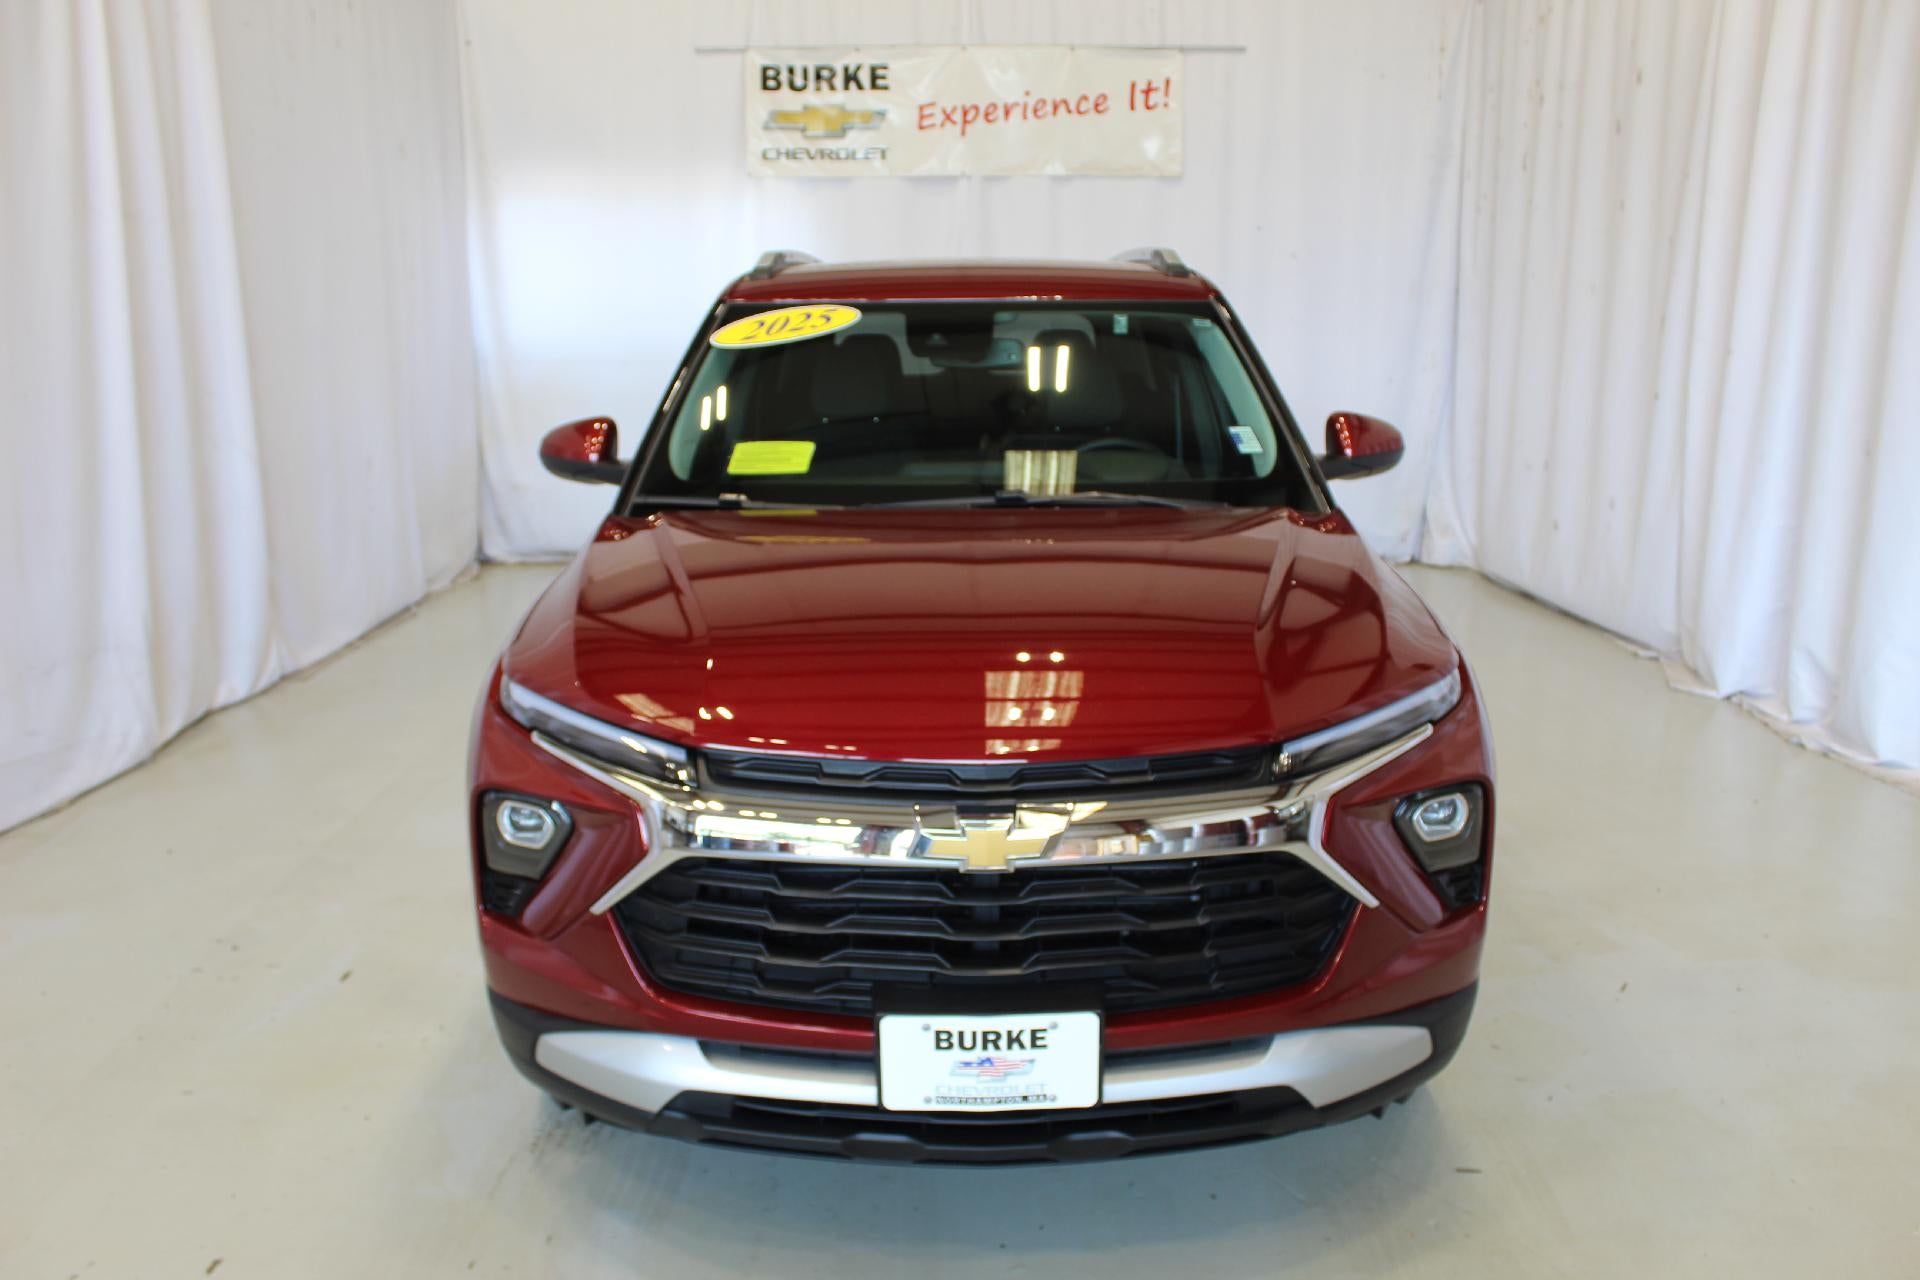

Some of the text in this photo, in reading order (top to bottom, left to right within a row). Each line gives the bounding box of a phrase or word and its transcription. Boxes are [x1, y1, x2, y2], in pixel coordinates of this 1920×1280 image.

[761, 64, 889, 91] BURKE
[917, 78, 1172, 136] Experience It!
[761, 147, 889, 160] CHEVROLET
[740, 307, 838, 341] 2025
[934, 1028, 1048, 1051] BURKE
[935, 1083, 1048, 1096] CHEVROLET
